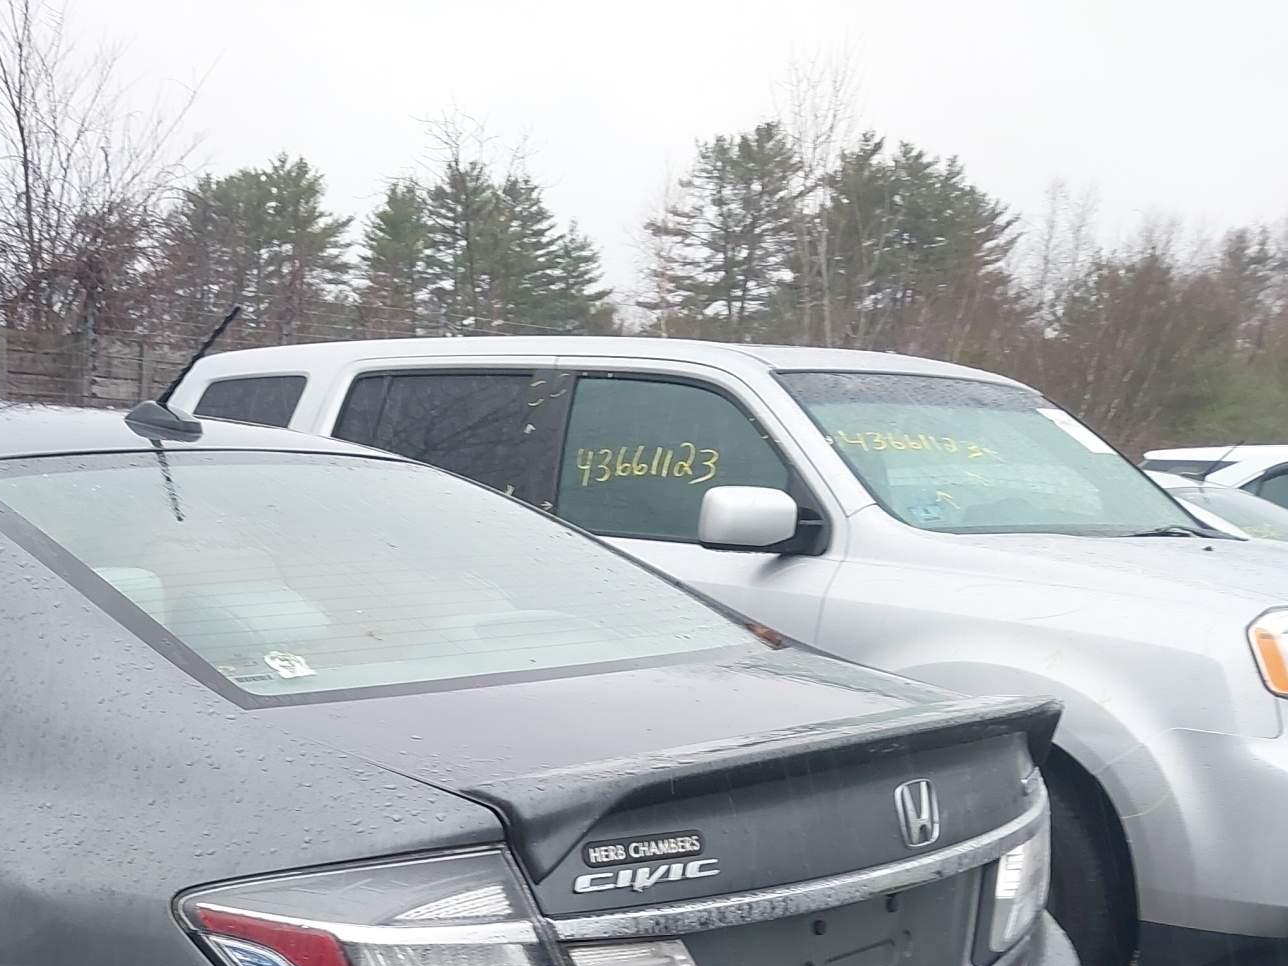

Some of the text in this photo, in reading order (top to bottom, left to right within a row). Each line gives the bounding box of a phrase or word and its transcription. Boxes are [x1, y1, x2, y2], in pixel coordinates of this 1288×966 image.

[576, 442, 719, 487] 43661123
[588, 836, 700, 863] HERB CHAMBERS
[574, 858, 720, 893] CIVIC
